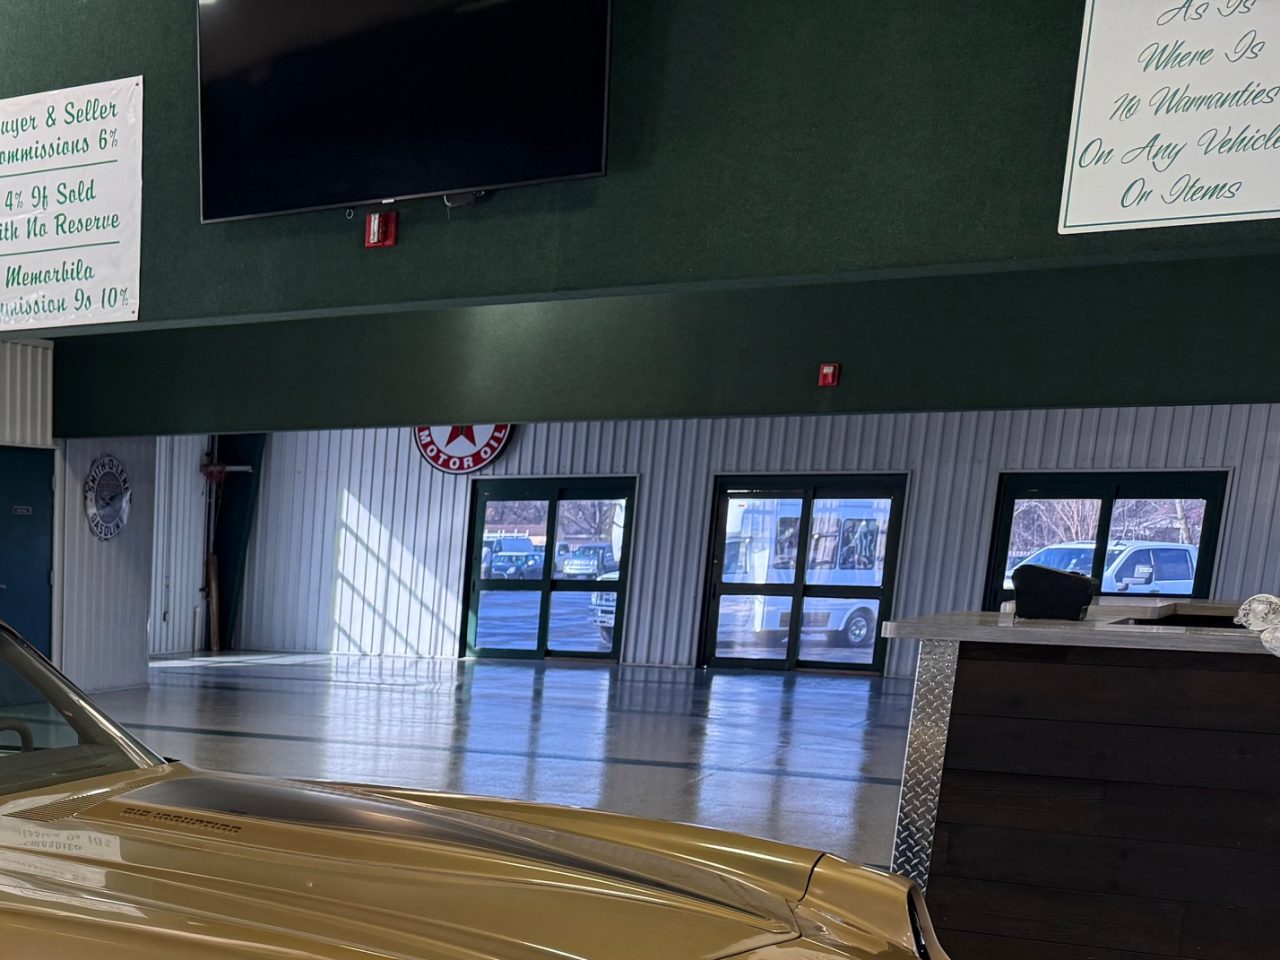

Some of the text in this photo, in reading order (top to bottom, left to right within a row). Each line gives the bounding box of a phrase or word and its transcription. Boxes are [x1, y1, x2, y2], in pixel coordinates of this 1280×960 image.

[1156, 0, 1210, 26] As
[1137, 29, 1265, 73] Where Is
[45, 105, 57, 128] &
[64, 98, 118, 125] Seller
[1109, 81, 1280, 121] No Warranties
[98, 128, 119, 150] 6%
[1078, 137, 1114, 168] On
[1121, 133, 1187, 172] Any
[5, 179, 96, 211] 4% If Sold
[1160, 174, 1242, 204] Items
[26, 216, 48, 240] No
[54, 213, 120, 236] Reserve
[5, 258, 95, 289] Memorbila
[74, 288, 92, 311] Is
[101, 287, 129, 307] 10%
[419, 428, 505, 469] MOTOR OIL
